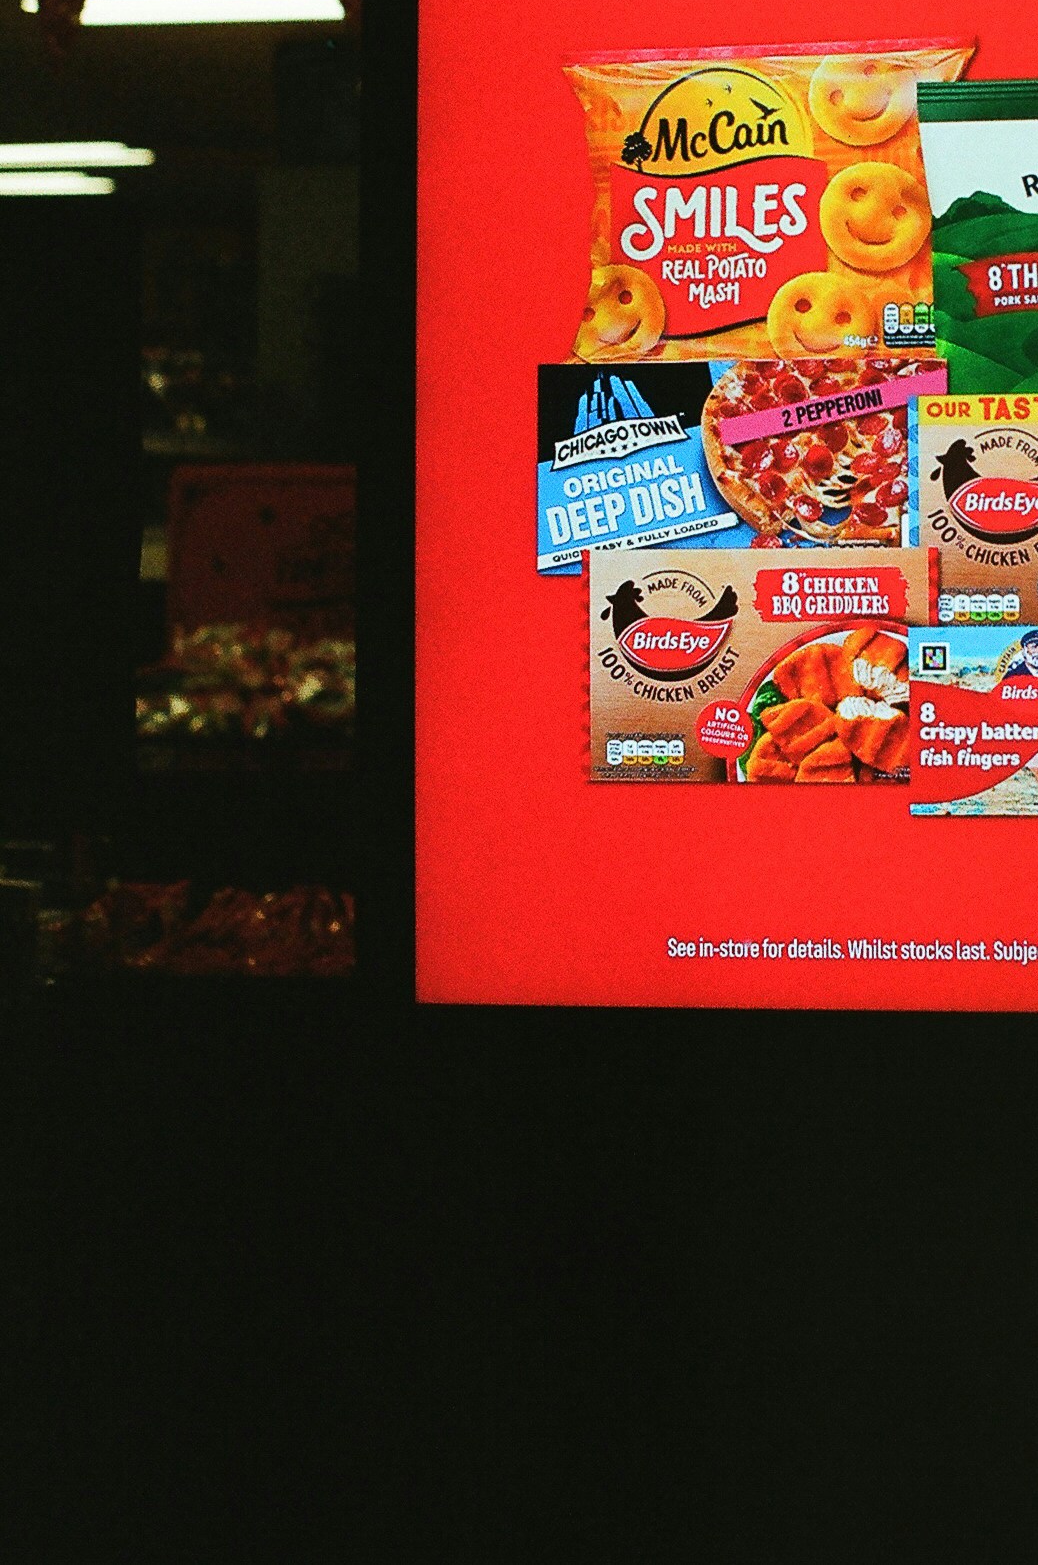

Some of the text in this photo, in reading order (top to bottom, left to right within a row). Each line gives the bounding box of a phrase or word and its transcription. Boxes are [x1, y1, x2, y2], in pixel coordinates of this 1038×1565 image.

[653, 110, 789, 162] McCain
[620, 183, 807, 261] SMILES
[667, 242, 737, 253] MADE WITH
[662, 253, 767, 285] REAL POTATO
[688, 281, 740, 309] MASH
[994, 295, 1021, 306] PORK
[782, 388, 883, 428] 2 PEPPERONI
[926, 401, 971, 418] OUR
[558, 420, 681, 461] CHICAGO TOWN
[980, 436, 1013, 454] MADE
[563, 455, 684, 498] ORIGINAL
[546, 472, 706, 545] DEEP DISH
[638, 531, 670, 543] FULLY
[674, 520, 718, 535] LOADED
[928, 509, 964, 549] 100%
[966, 544, 1031, 567] CHICKEN
[647, 578, 708, 608] MADE FROM
[804, 577, 878, 594] CHICKEN
[772, 595, 889, 618] BBQ GRIDDLERS
[598, 646, 740, 702] 100% CHICKEN BREAST
[715, 707, 740, 722] NO
[920, 702, 936, 723] 8
[701, 728, 736, 739] COLOURS
[707, 720, 745, 733] ARTIFICIAL
[920, 722, 978, 745] crispy
[920, 747, 1020, 771] fish fingers
[667, 938, 696, 958] See
[699, 937, 760, 958] in-store
[762, 938, 785, 958] for
[787, 938, 845, 959] details.
[848, 939, 898, 960] Whilst
[900, 940, 953, 960] stocks
[956, 940, 990, 961] last.
